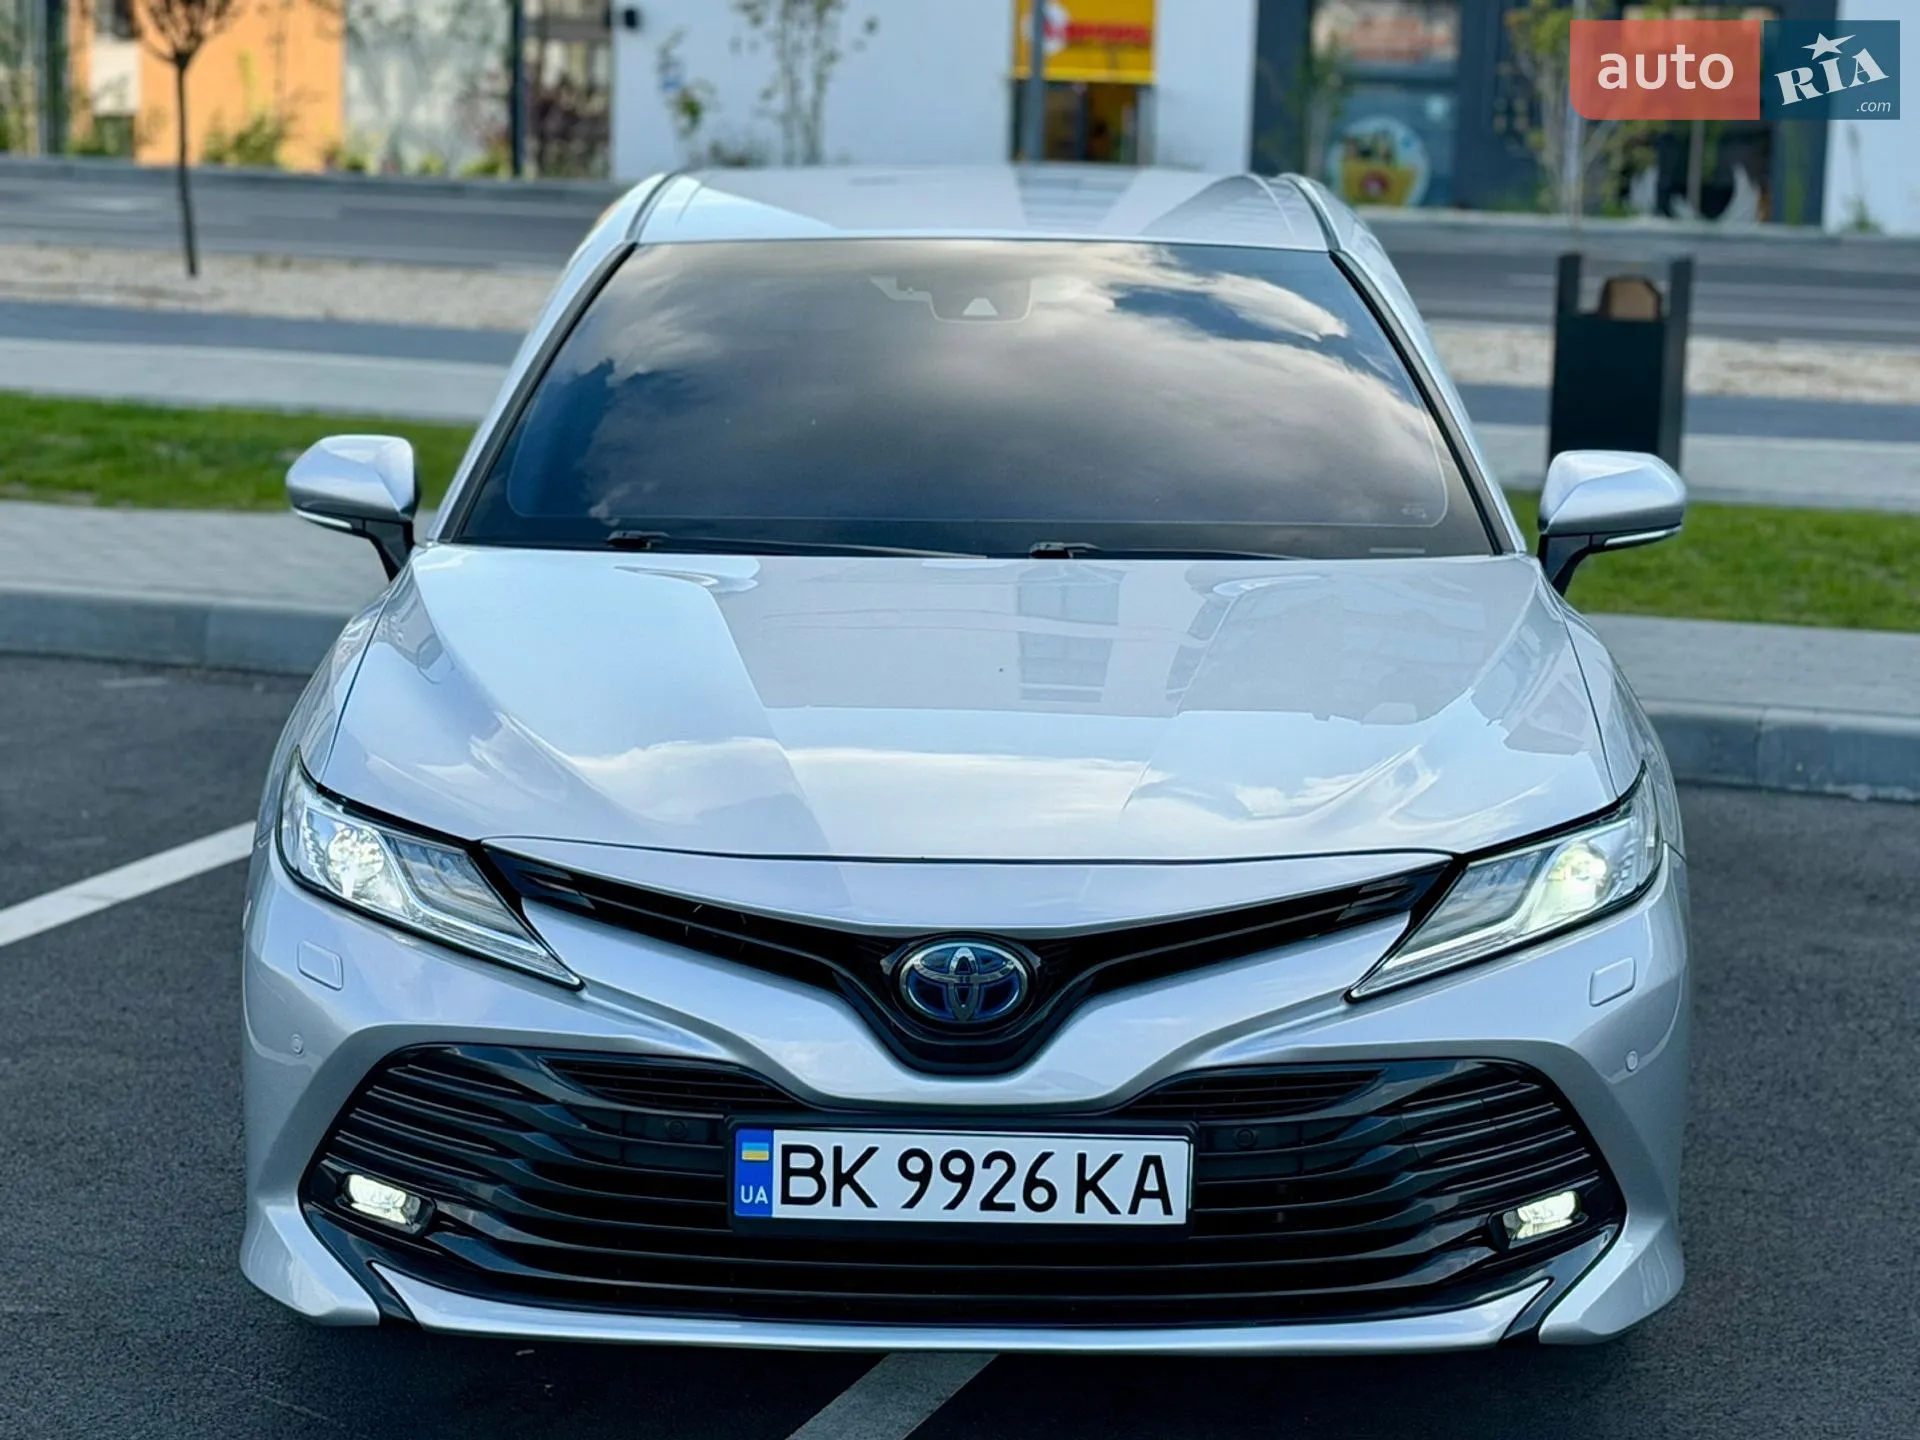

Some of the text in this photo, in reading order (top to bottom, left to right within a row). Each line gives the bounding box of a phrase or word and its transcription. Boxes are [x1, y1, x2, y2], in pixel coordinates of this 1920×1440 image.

[740, 1184, 768, 1205] UA
[780, 1143, 1174, 1216] BK 9926 KA
